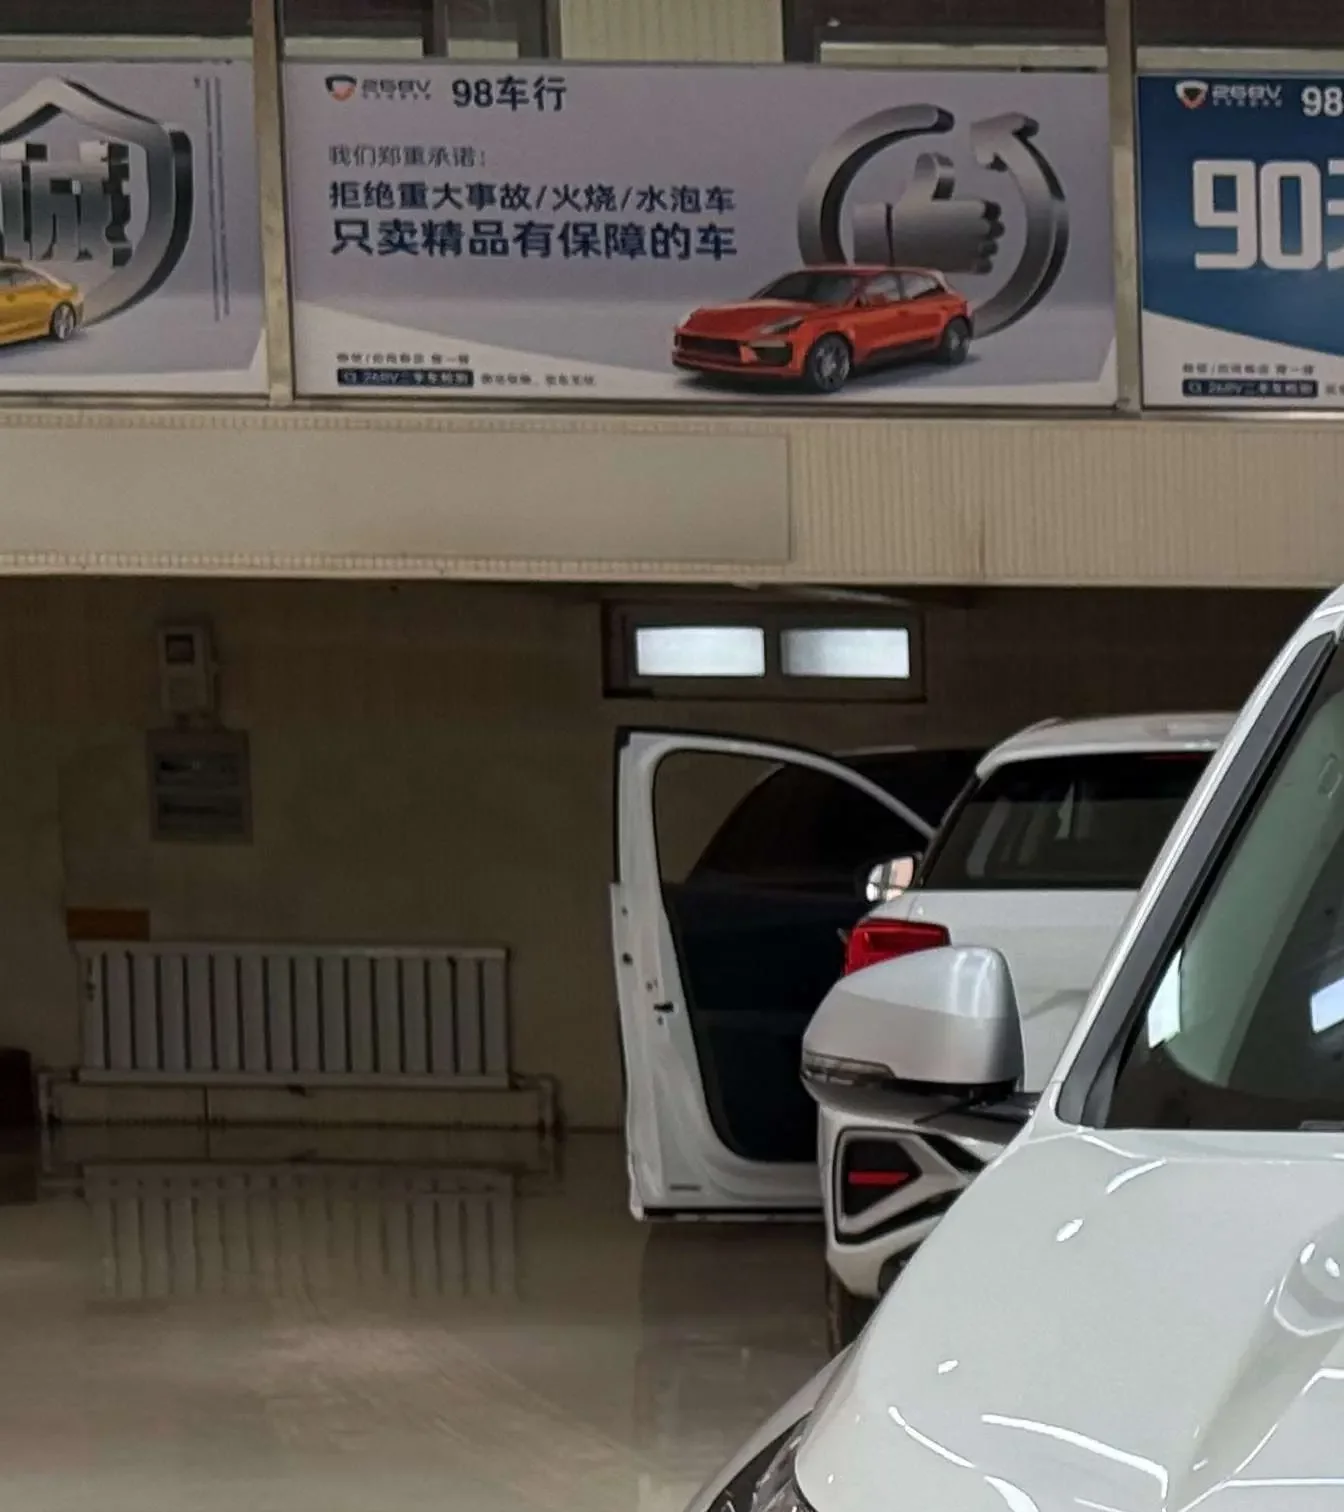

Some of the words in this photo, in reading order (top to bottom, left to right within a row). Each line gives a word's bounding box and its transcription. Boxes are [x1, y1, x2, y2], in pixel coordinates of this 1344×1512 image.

[451, 75, 567, 112] 98车行
[330, 181, 734, 213] 拒绝重大事故/火烧/水泡车
[331, 218, 737, 260] 只卖精品有保障的车
